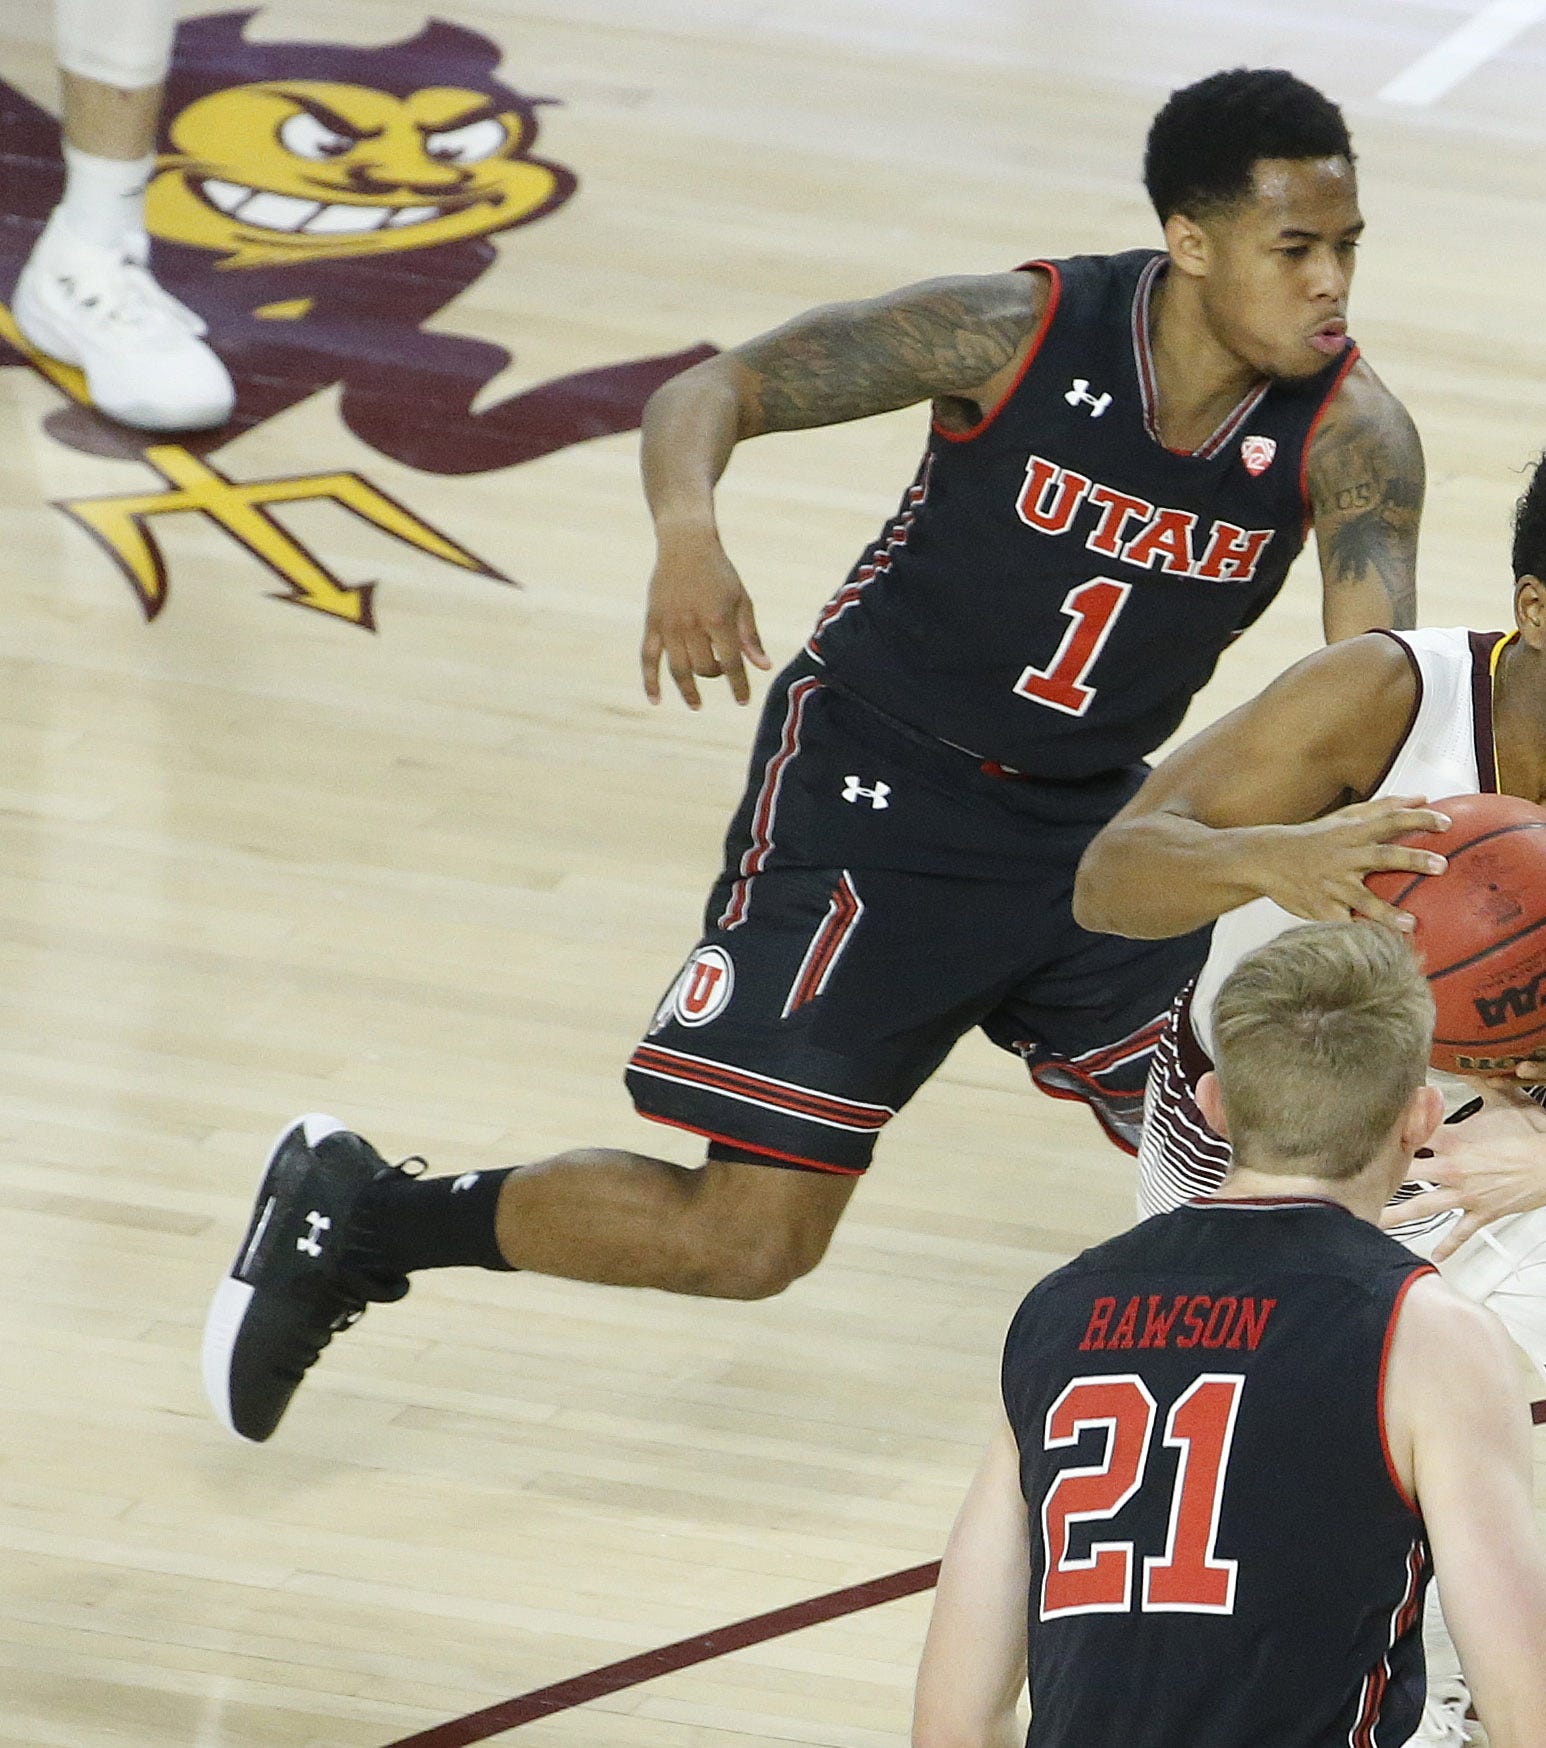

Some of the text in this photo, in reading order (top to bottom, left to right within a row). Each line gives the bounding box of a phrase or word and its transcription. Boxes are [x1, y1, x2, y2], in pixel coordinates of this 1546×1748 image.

[1015, 455, 1275, 582] UTAH
[1013, 575, 1132, 717] 1
[684, 961, 723, 1013] U
[1079, 1294, 1277, 1351] RAWSON
[1039, 1373, 1246, 1622] 21
